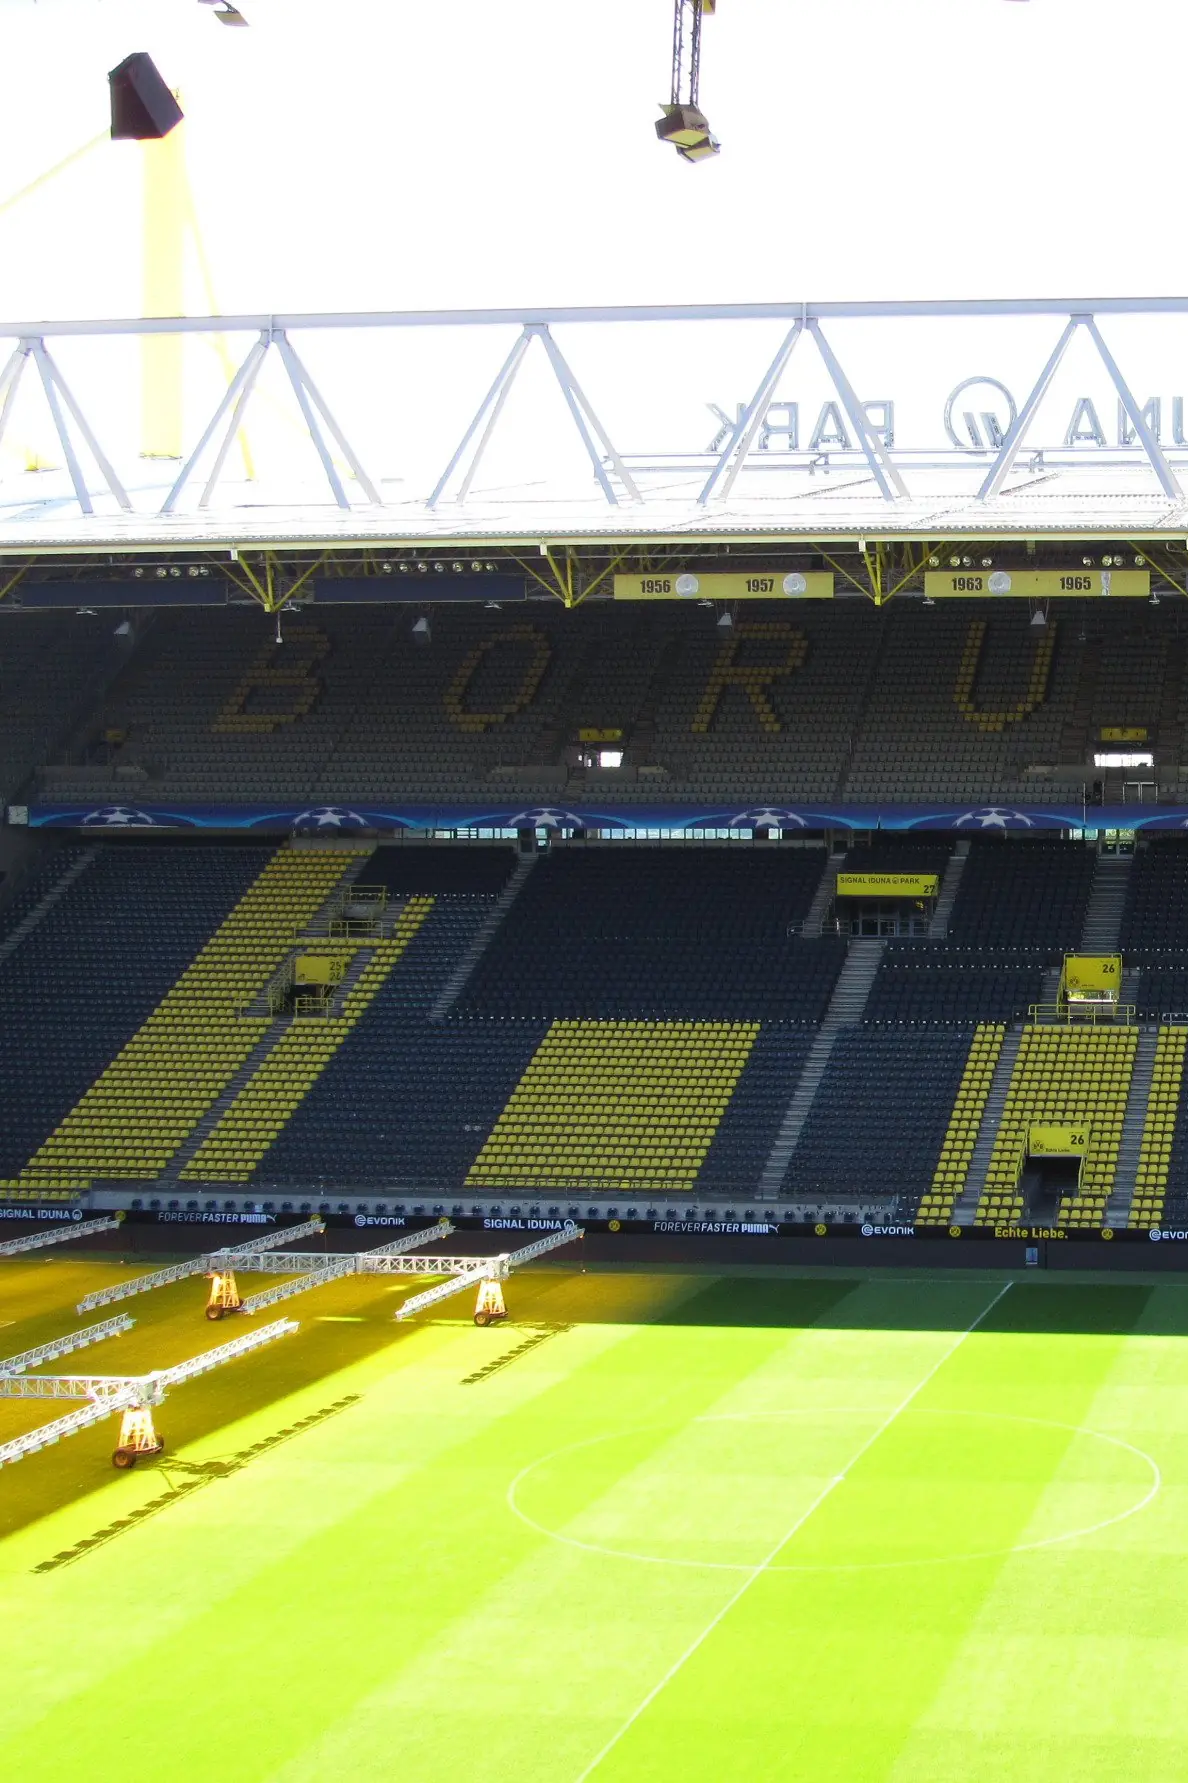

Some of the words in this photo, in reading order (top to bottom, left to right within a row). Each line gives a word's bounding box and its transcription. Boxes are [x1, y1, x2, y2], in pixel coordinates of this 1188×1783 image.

[640, 579, 671, 594] 1956
[745, 578, 774, 593] 1957
[952, 577, 983, 592] 1963
[1059, 576, 1092, 591] 1965
[840, 876, 867, 884] SIGNAL
[868, 876, 892, 885] IDUNA
[900, 877, 920, 885] PARK
[923, 885, 935, 894] 27
[1102, 964, 1115, 974] 26
[1070, 1134, 1085, 1145] 26
[37, 1209, 70, 1219] IDUNA
[240, 1213, 267, 1223] PUMA
[483, 1218, 525, 1229] SIGNAL
[527, 1219, 562, 1229] IDUNA
[741, 1223, 769, 1233] PUMA
[994, 1227, 1028, 1238] Echte
[1031, 1227, 1068, 1239] Liebe.
